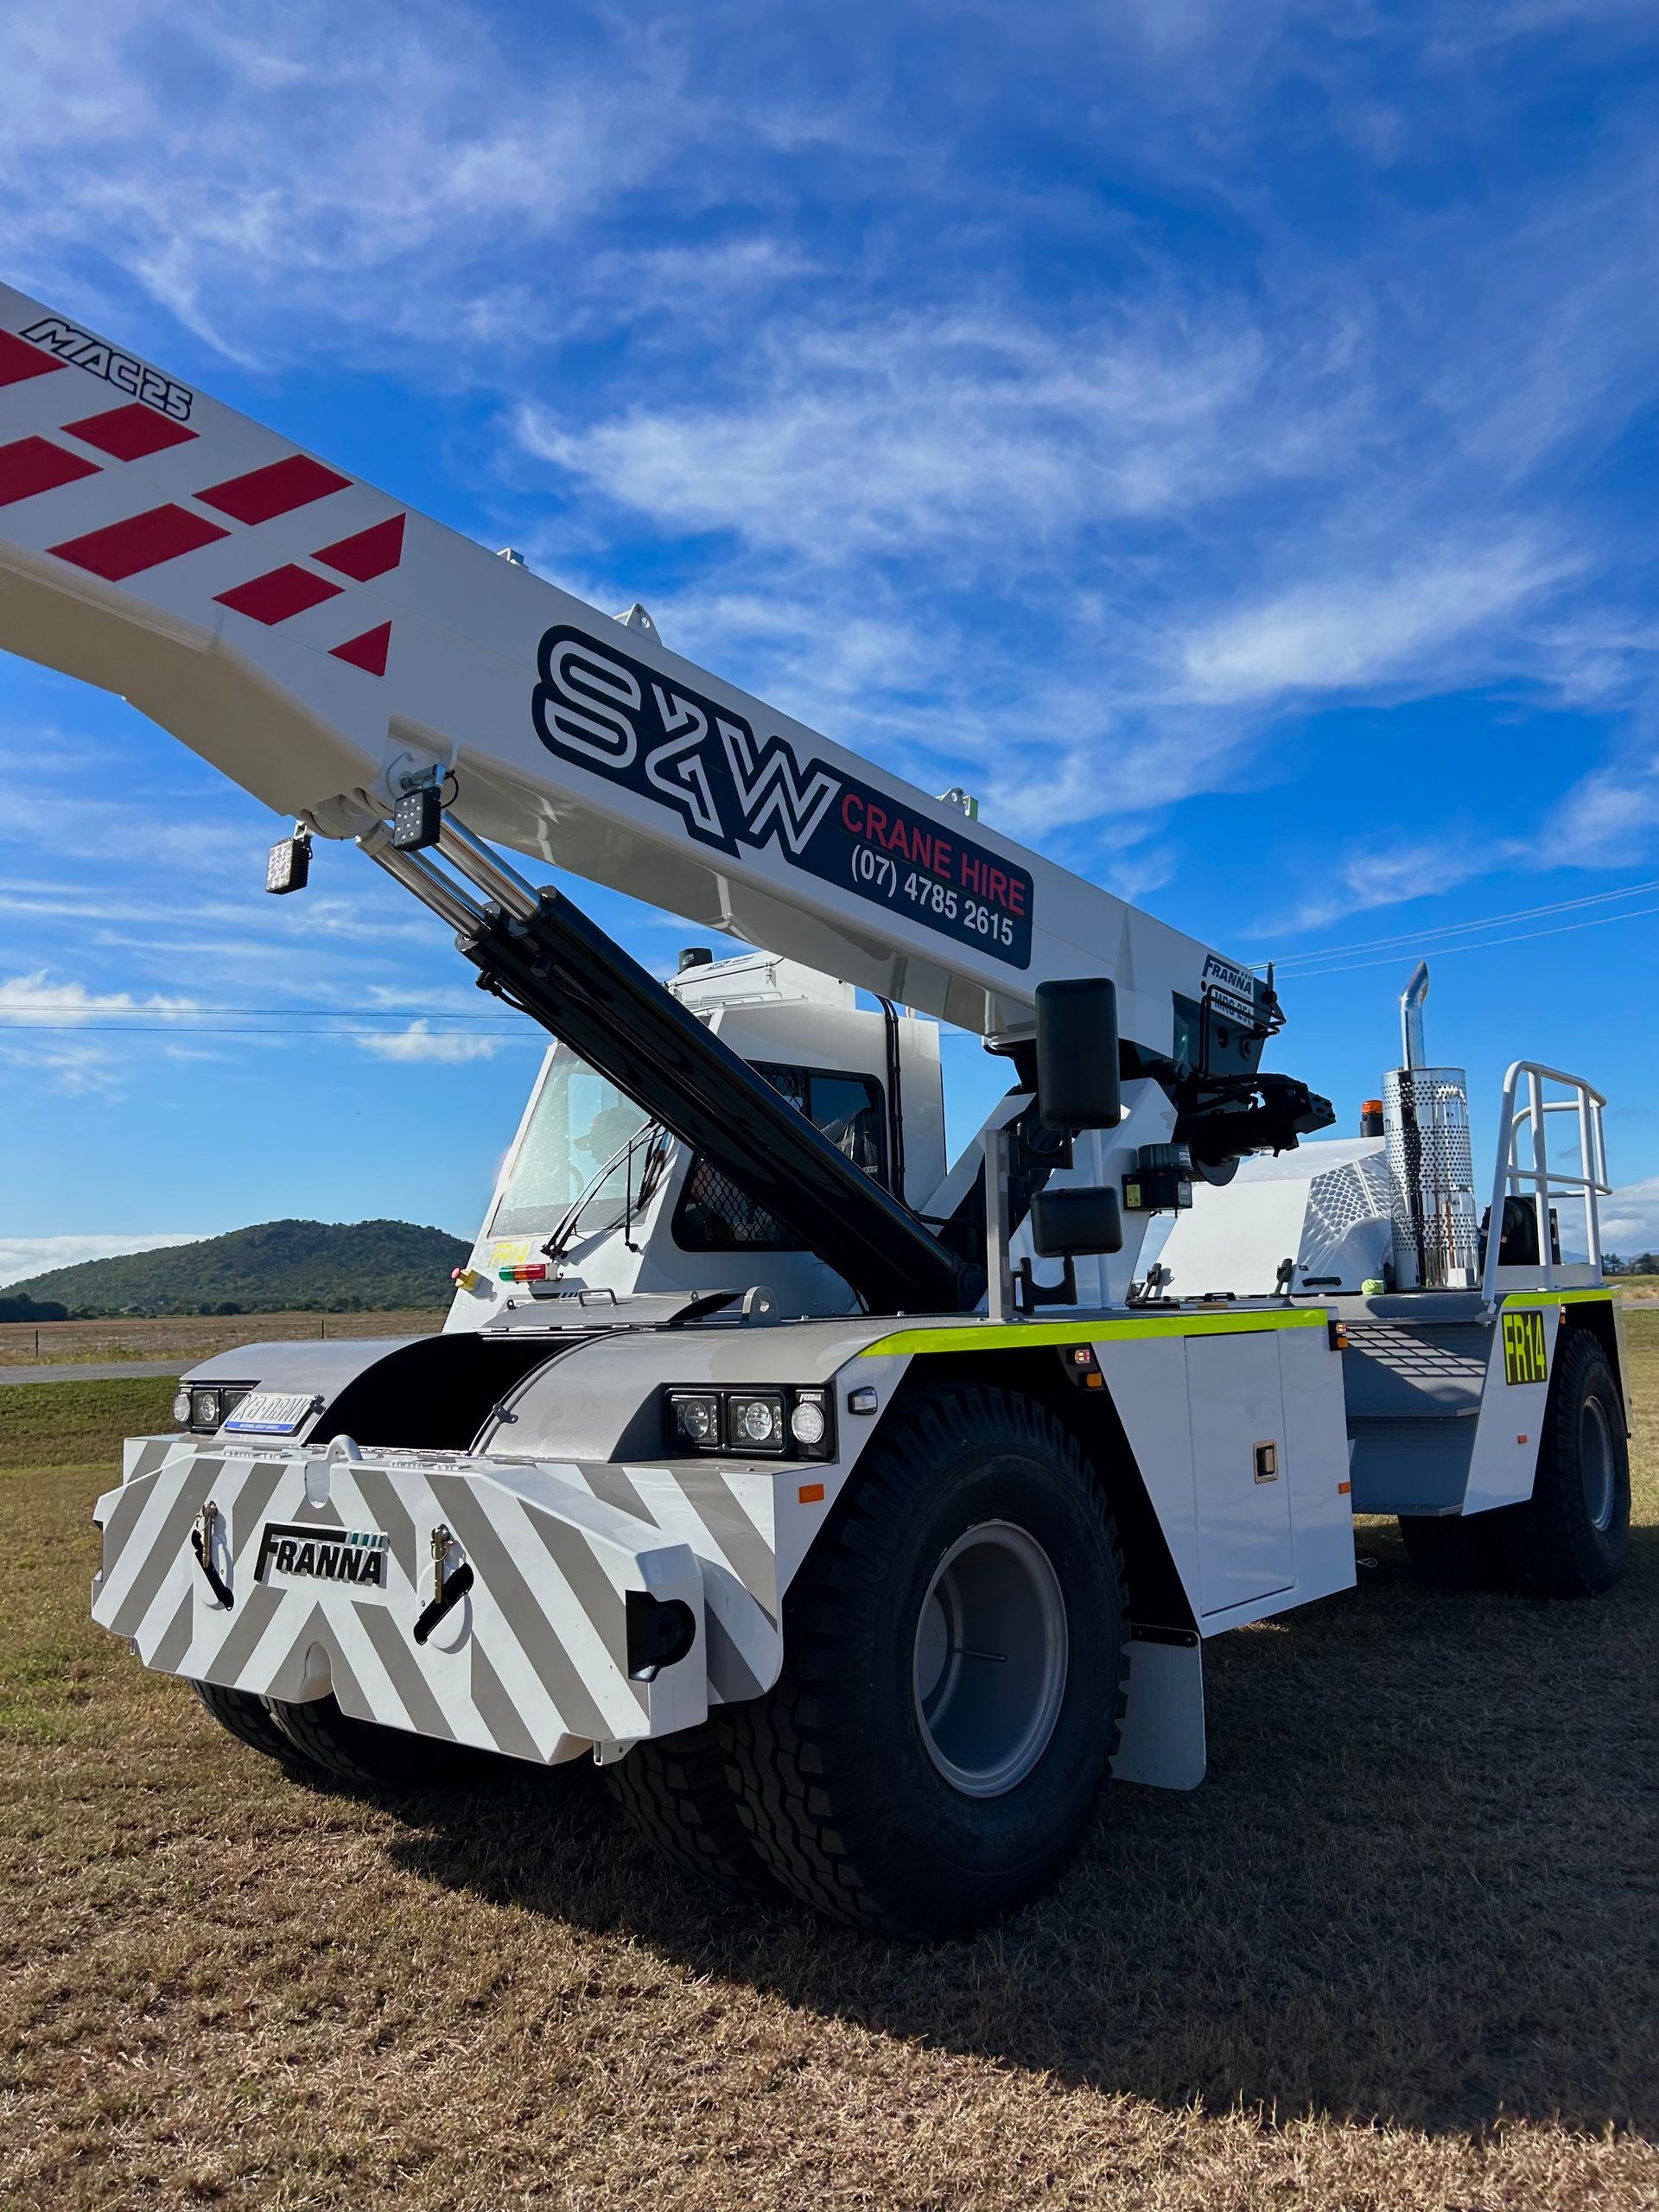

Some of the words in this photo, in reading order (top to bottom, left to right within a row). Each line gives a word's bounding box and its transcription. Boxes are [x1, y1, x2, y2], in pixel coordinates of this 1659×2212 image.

[842, 793, 951, 879] CRANE
[961, 853, 1026, 916] HIRE
[851, 844, 897, 898] (07)
[904, 873, 957, 919] 4785
[963, 900, 1013, 946] 2615
[1202, 953, 1252, 995] FRANNA
[1503, 1313, 1546, 1382] FR14
[254, 1522, 382, 1584] FRANNA
